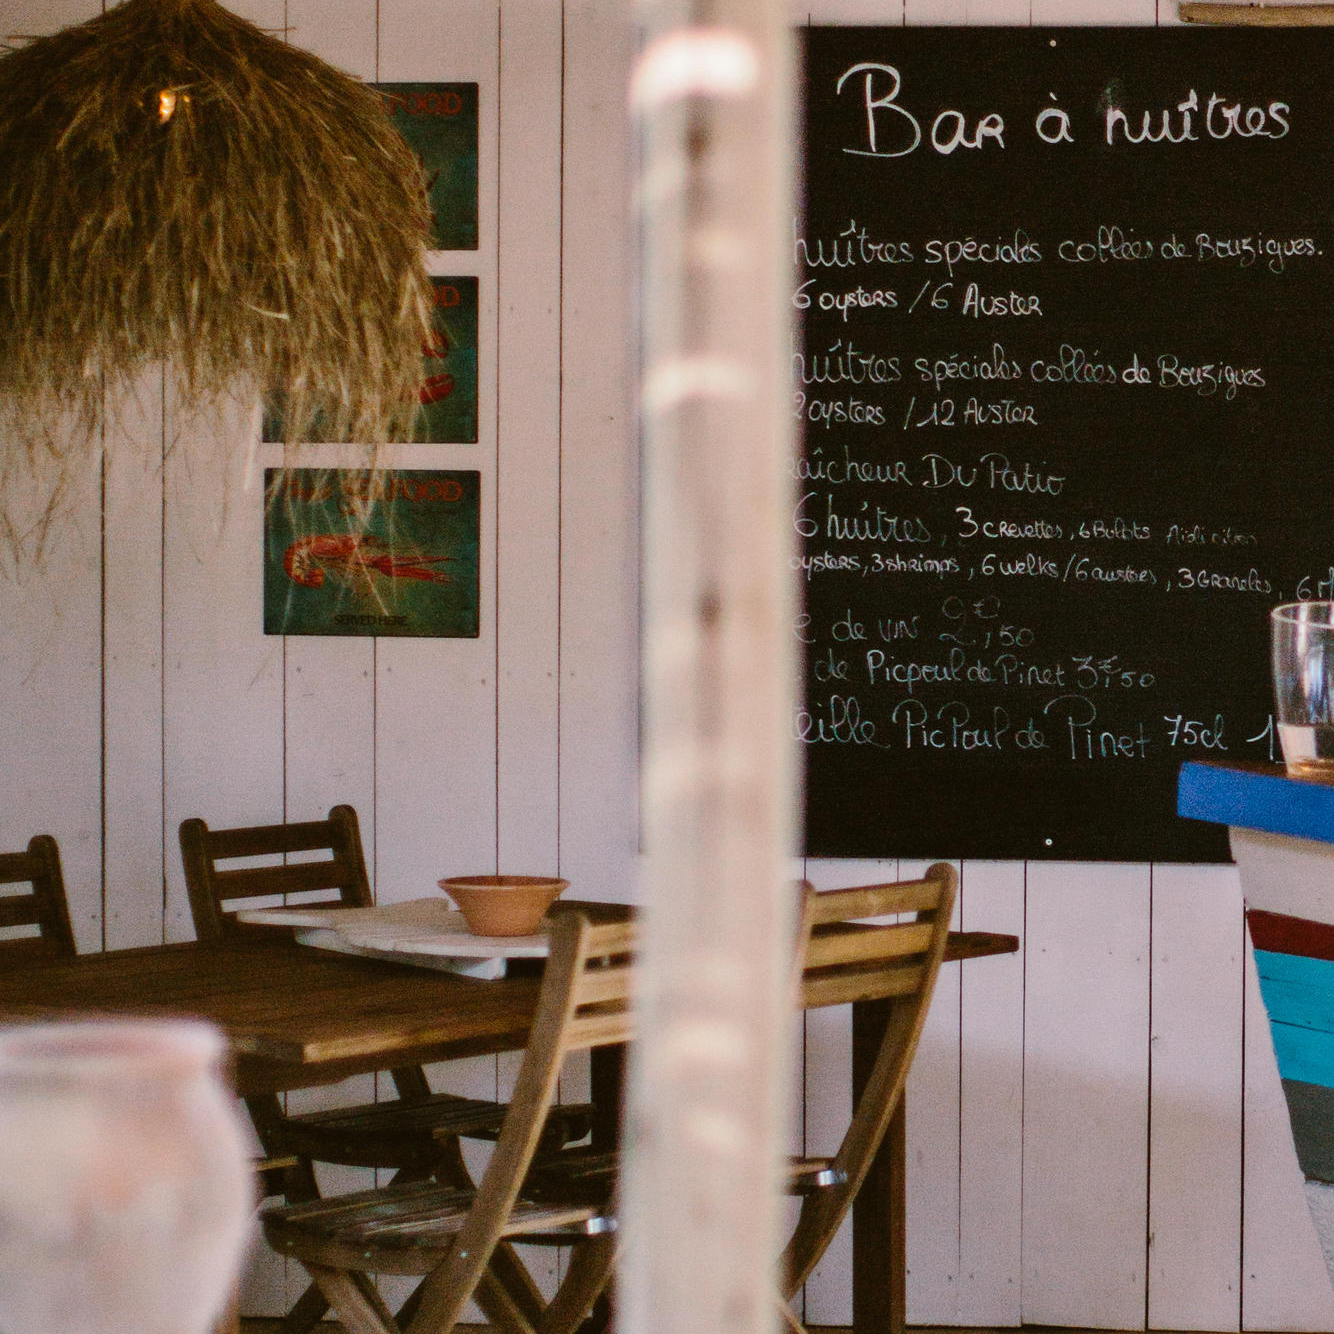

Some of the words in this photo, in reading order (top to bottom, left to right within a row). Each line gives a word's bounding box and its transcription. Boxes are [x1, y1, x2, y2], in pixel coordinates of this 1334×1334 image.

[1036, 92, 1075, 144] à
[792, 278, 818, 310] 6
[979, 452, 1067, 495] Patio
[792, 491, 819, 538] 6
[955, 506, 979, 538] 3
[981, 553, 997, 576] 6
[1178, 568, 1195, 589] 3
[1296, 575, 1312, 602] 6
